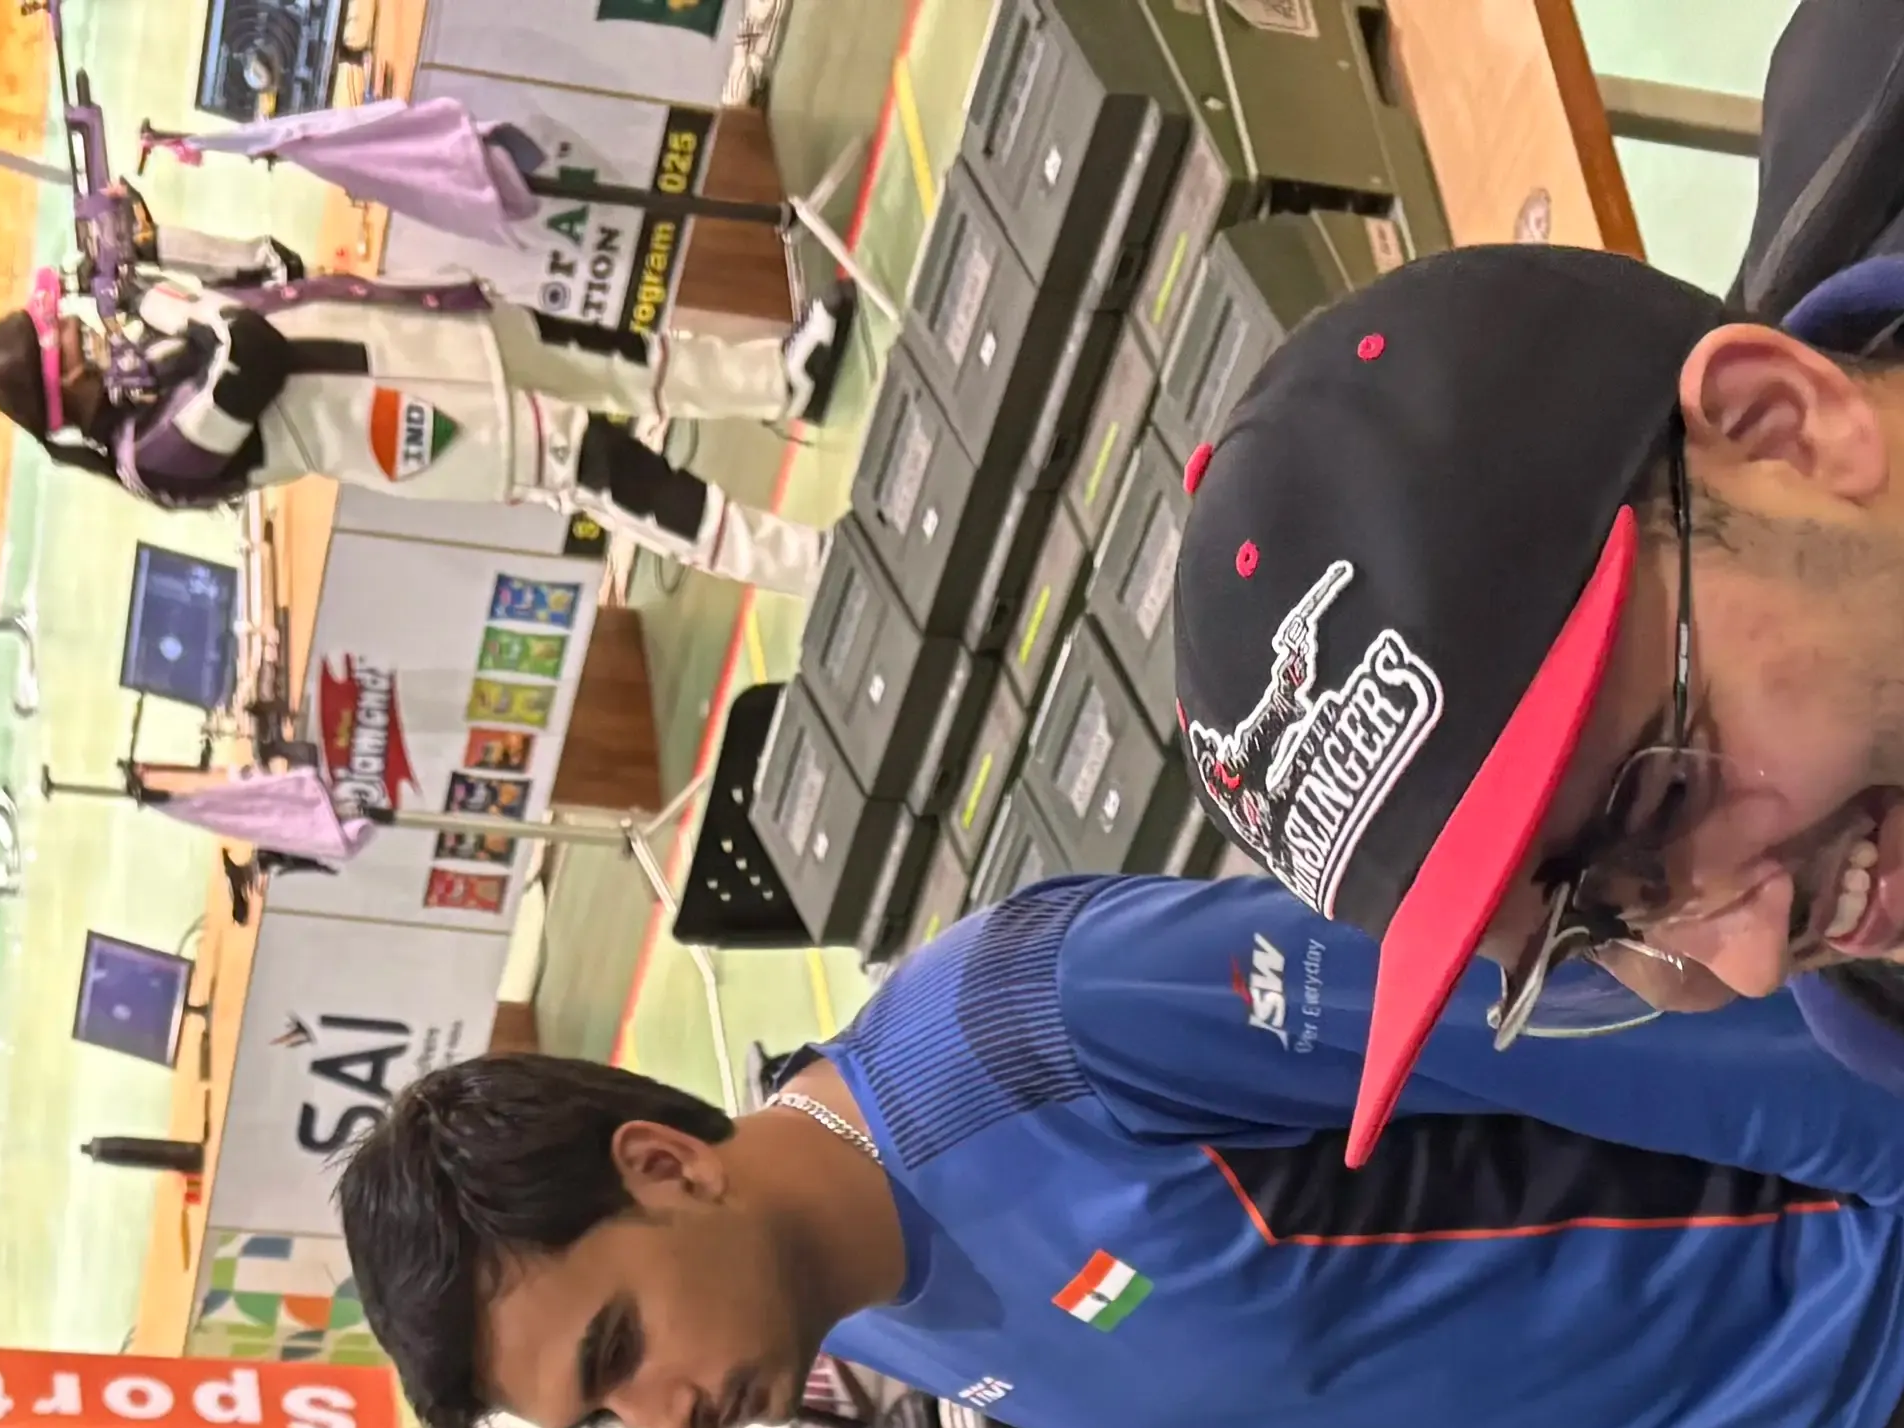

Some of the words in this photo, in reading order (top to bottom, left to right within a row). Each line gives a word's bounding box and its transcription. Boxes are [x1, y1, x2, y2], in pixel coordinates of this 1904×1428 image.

[629, 222, 675, 333] rogram
[403, 405, 427, 465] IND
[1245, 933, 1288, 1049] JSW
[296, 1014, 411, 1152] SAI
